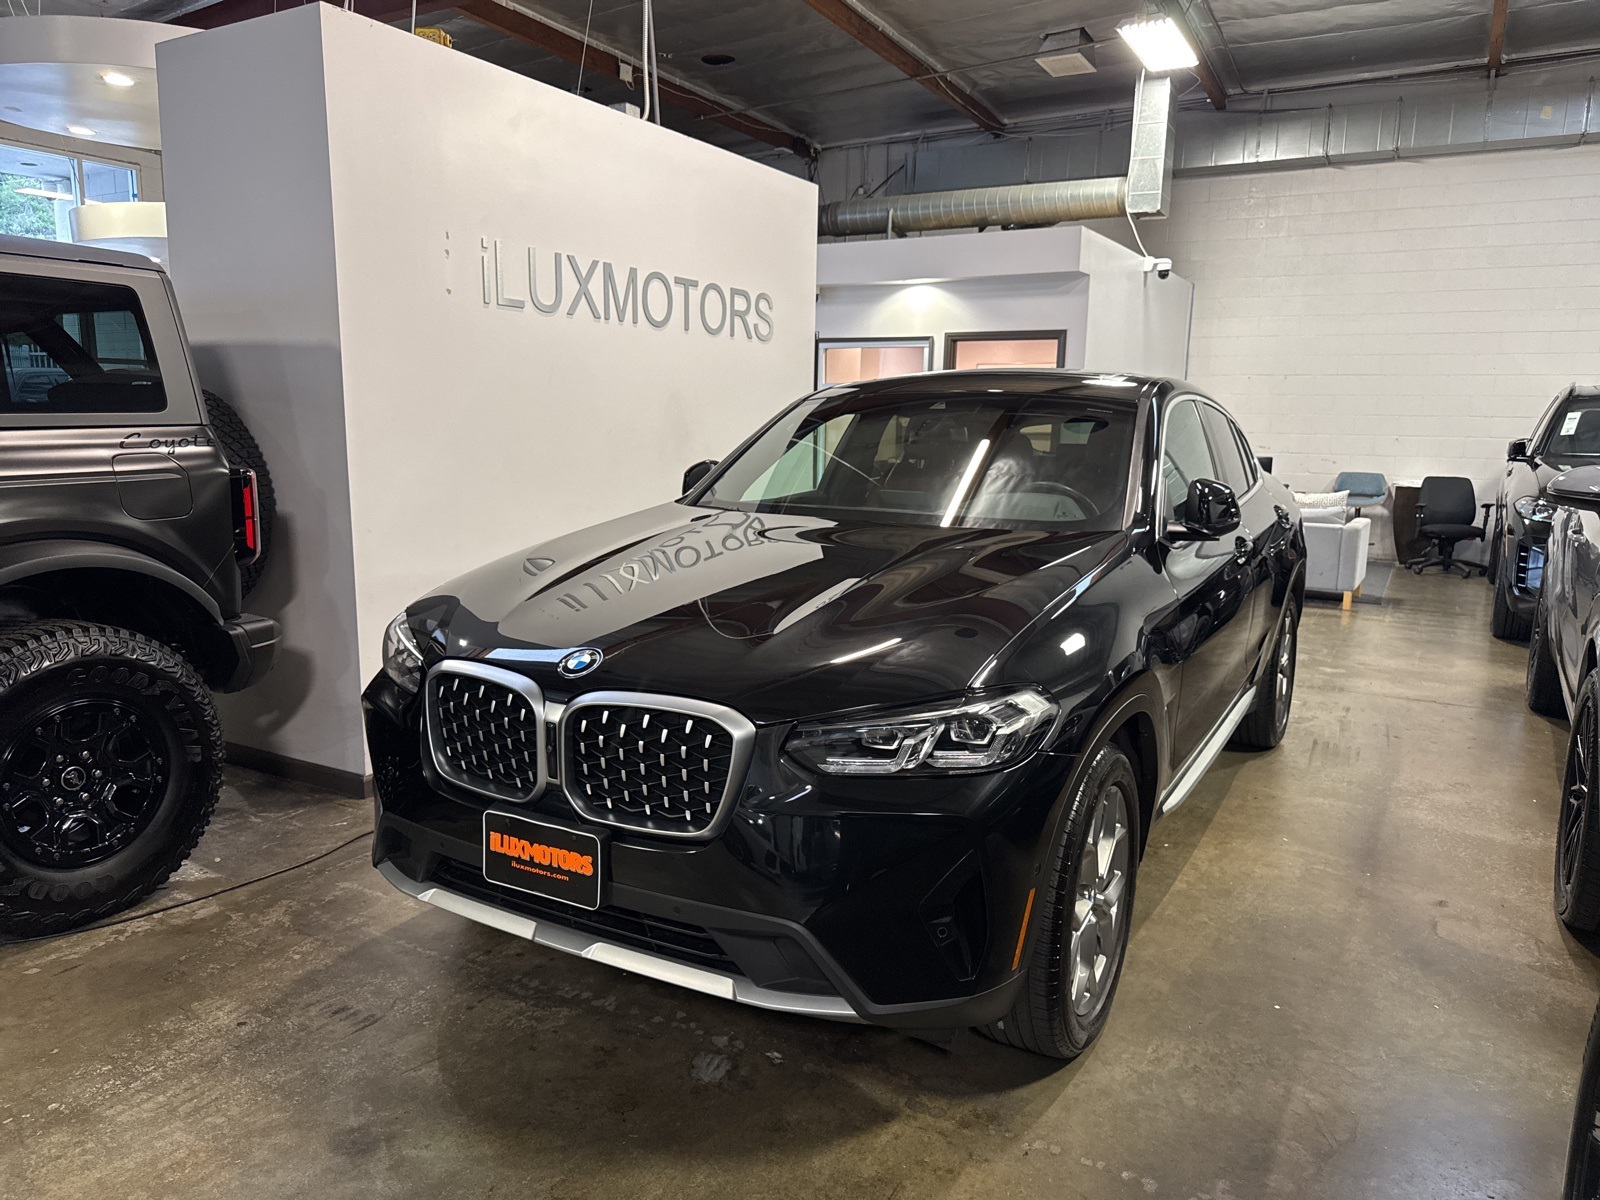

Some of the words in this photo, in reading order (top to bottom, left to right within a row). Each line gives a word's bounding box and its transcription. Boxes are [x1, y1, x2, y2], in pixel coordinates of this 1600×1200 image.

[481, 236, 774, 342] iLUXMOTORS
[489, 830, 594, 877] iLUXMOTORS
[511, 860, 570, 882] iluxmotors.com
